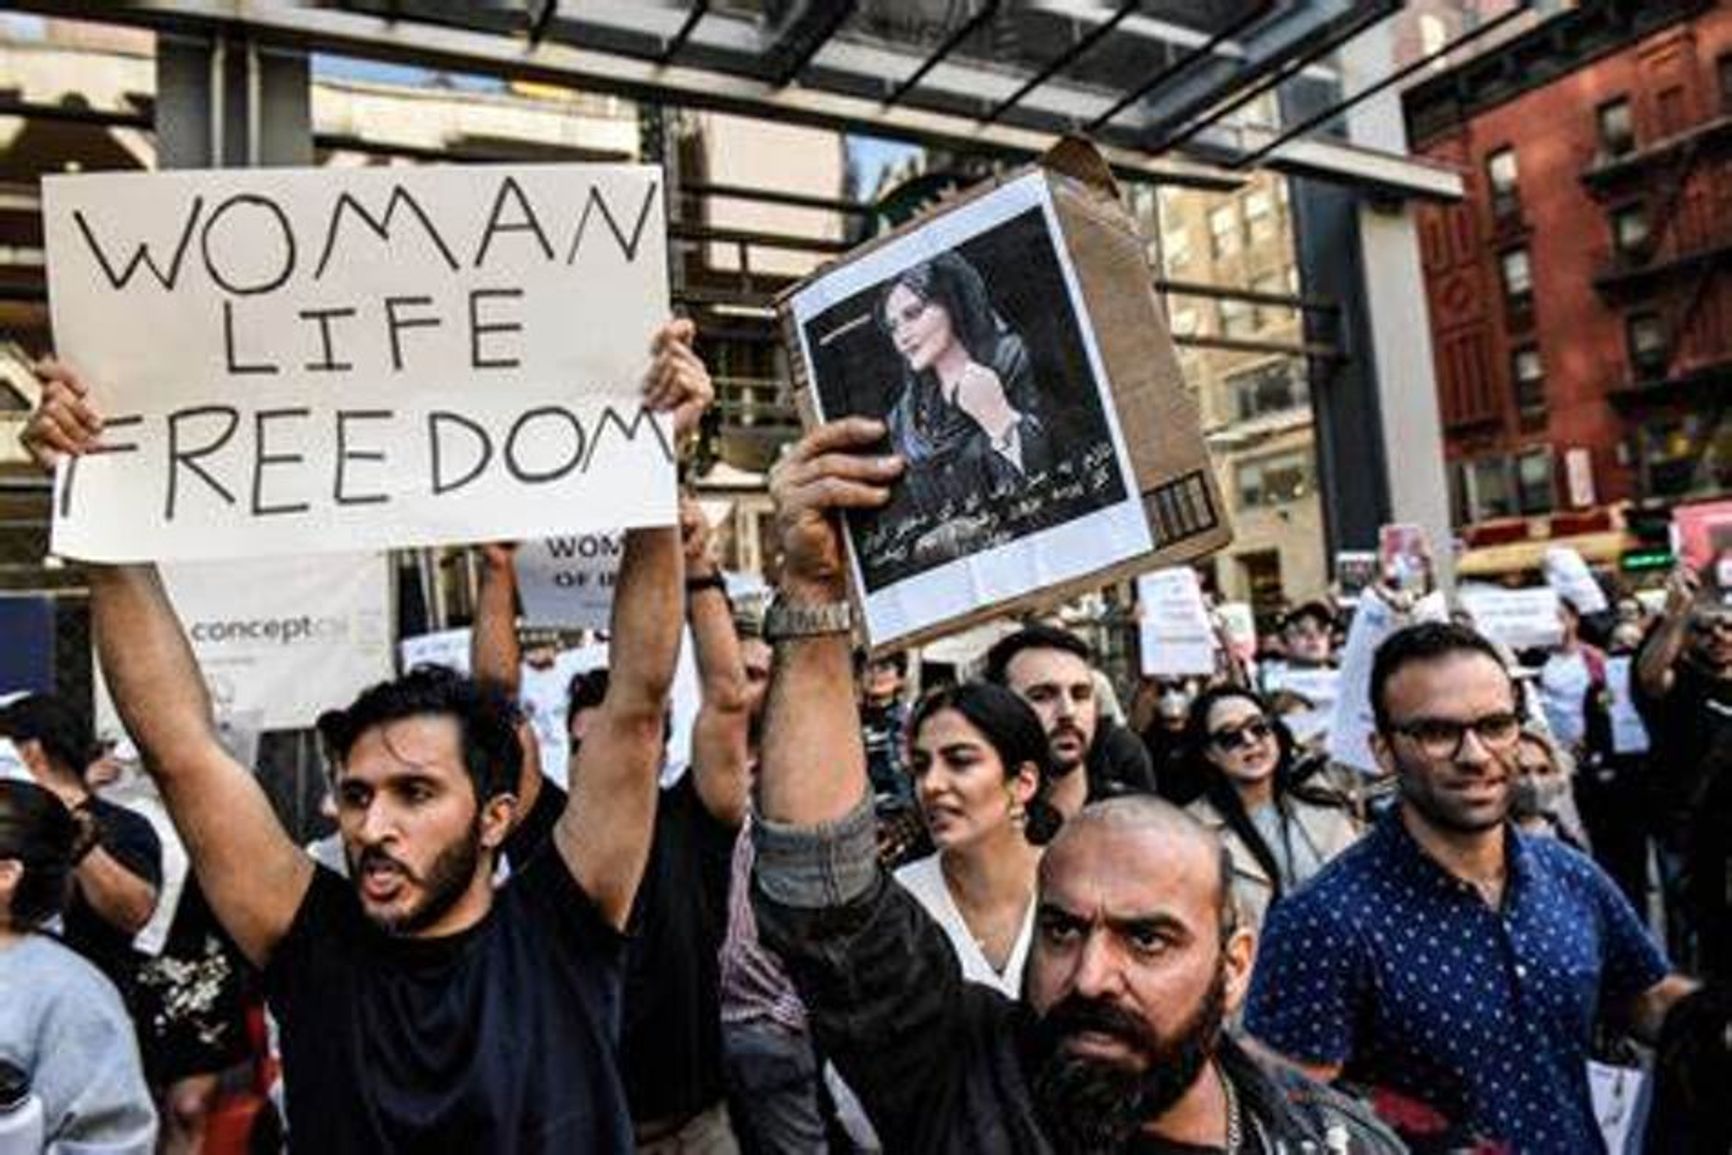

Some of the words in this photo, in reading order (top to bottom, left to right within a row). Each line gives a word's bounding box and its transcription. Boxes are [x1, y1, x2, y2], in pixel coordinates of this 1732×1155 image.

[74, 175, 657, 295] WOMAN
[223, 288, 524, 375] LIFE
[61, 405, 674, 519] FREEDOM
[190, 615, 312, 644] concept
